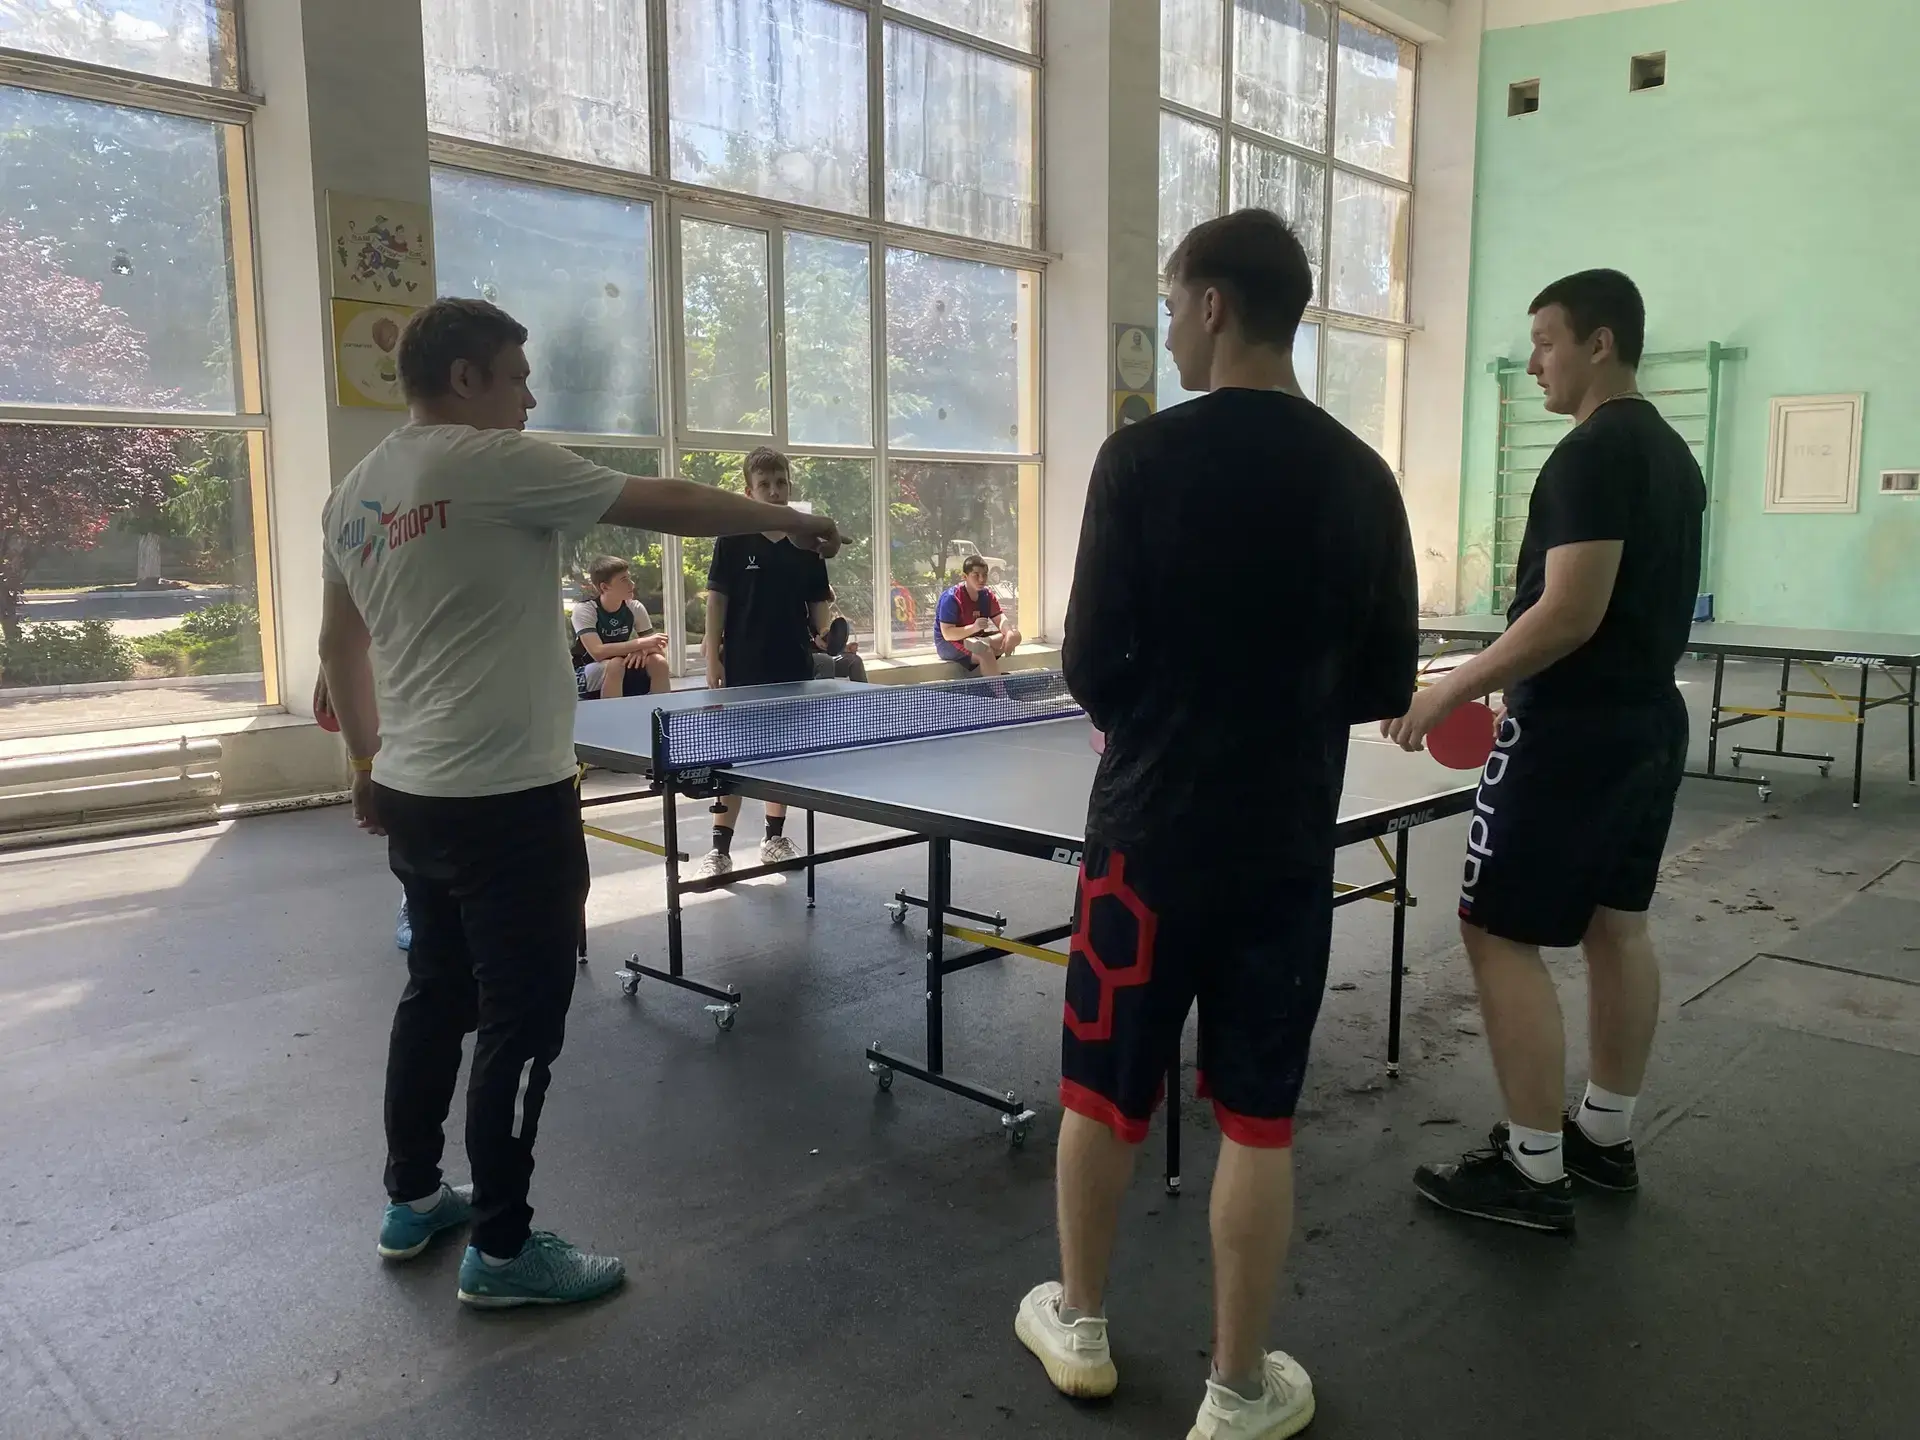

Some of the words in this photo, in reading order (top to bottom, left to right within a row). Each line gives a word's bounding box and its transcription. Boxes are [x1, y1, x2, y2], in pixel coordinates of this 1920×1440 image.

[388, 498, 452, 550] СПОРТ
[1833, 655, 1886, 665] DONIC
[1386, 808, 1435, 832] DONIC
